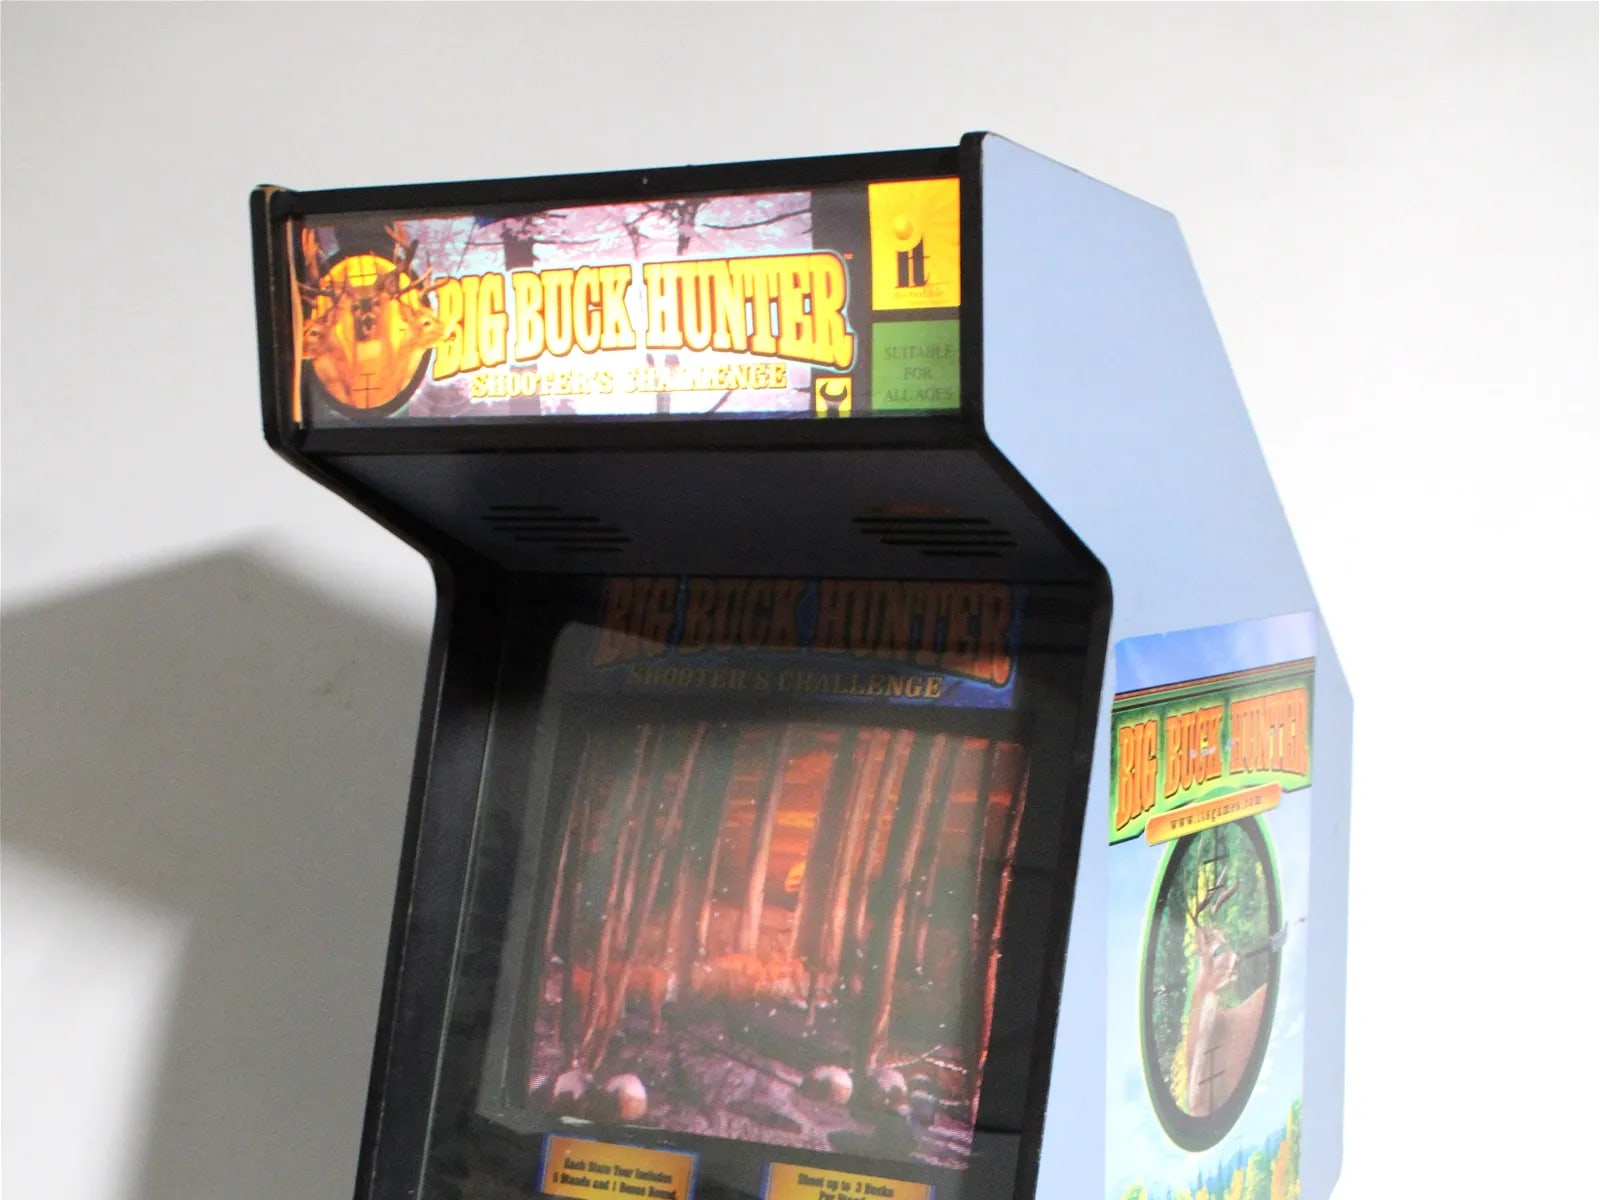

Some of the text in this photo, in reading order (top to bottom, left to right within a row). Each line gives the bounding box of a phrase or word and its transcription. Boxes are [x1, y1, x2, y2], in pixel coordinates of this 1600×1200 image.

[433, 251, 855, 381] BIG BUCK HUNTER
[884, 344, 953, 360] SUITABLE
[471, 362, 788, 398] SHOOTER'S CHALLENGE
[904, 366, 932, 380] FOR
[884, 387, 953, 401] ALL AGES
[594, 577, 1014, 687] BIG BUCK HUNTER
[626, 665, 945, 699] SHOOTER'S CHALLENGE
[1116, 687, 1309, 831] BIG BUCK HUNTER
